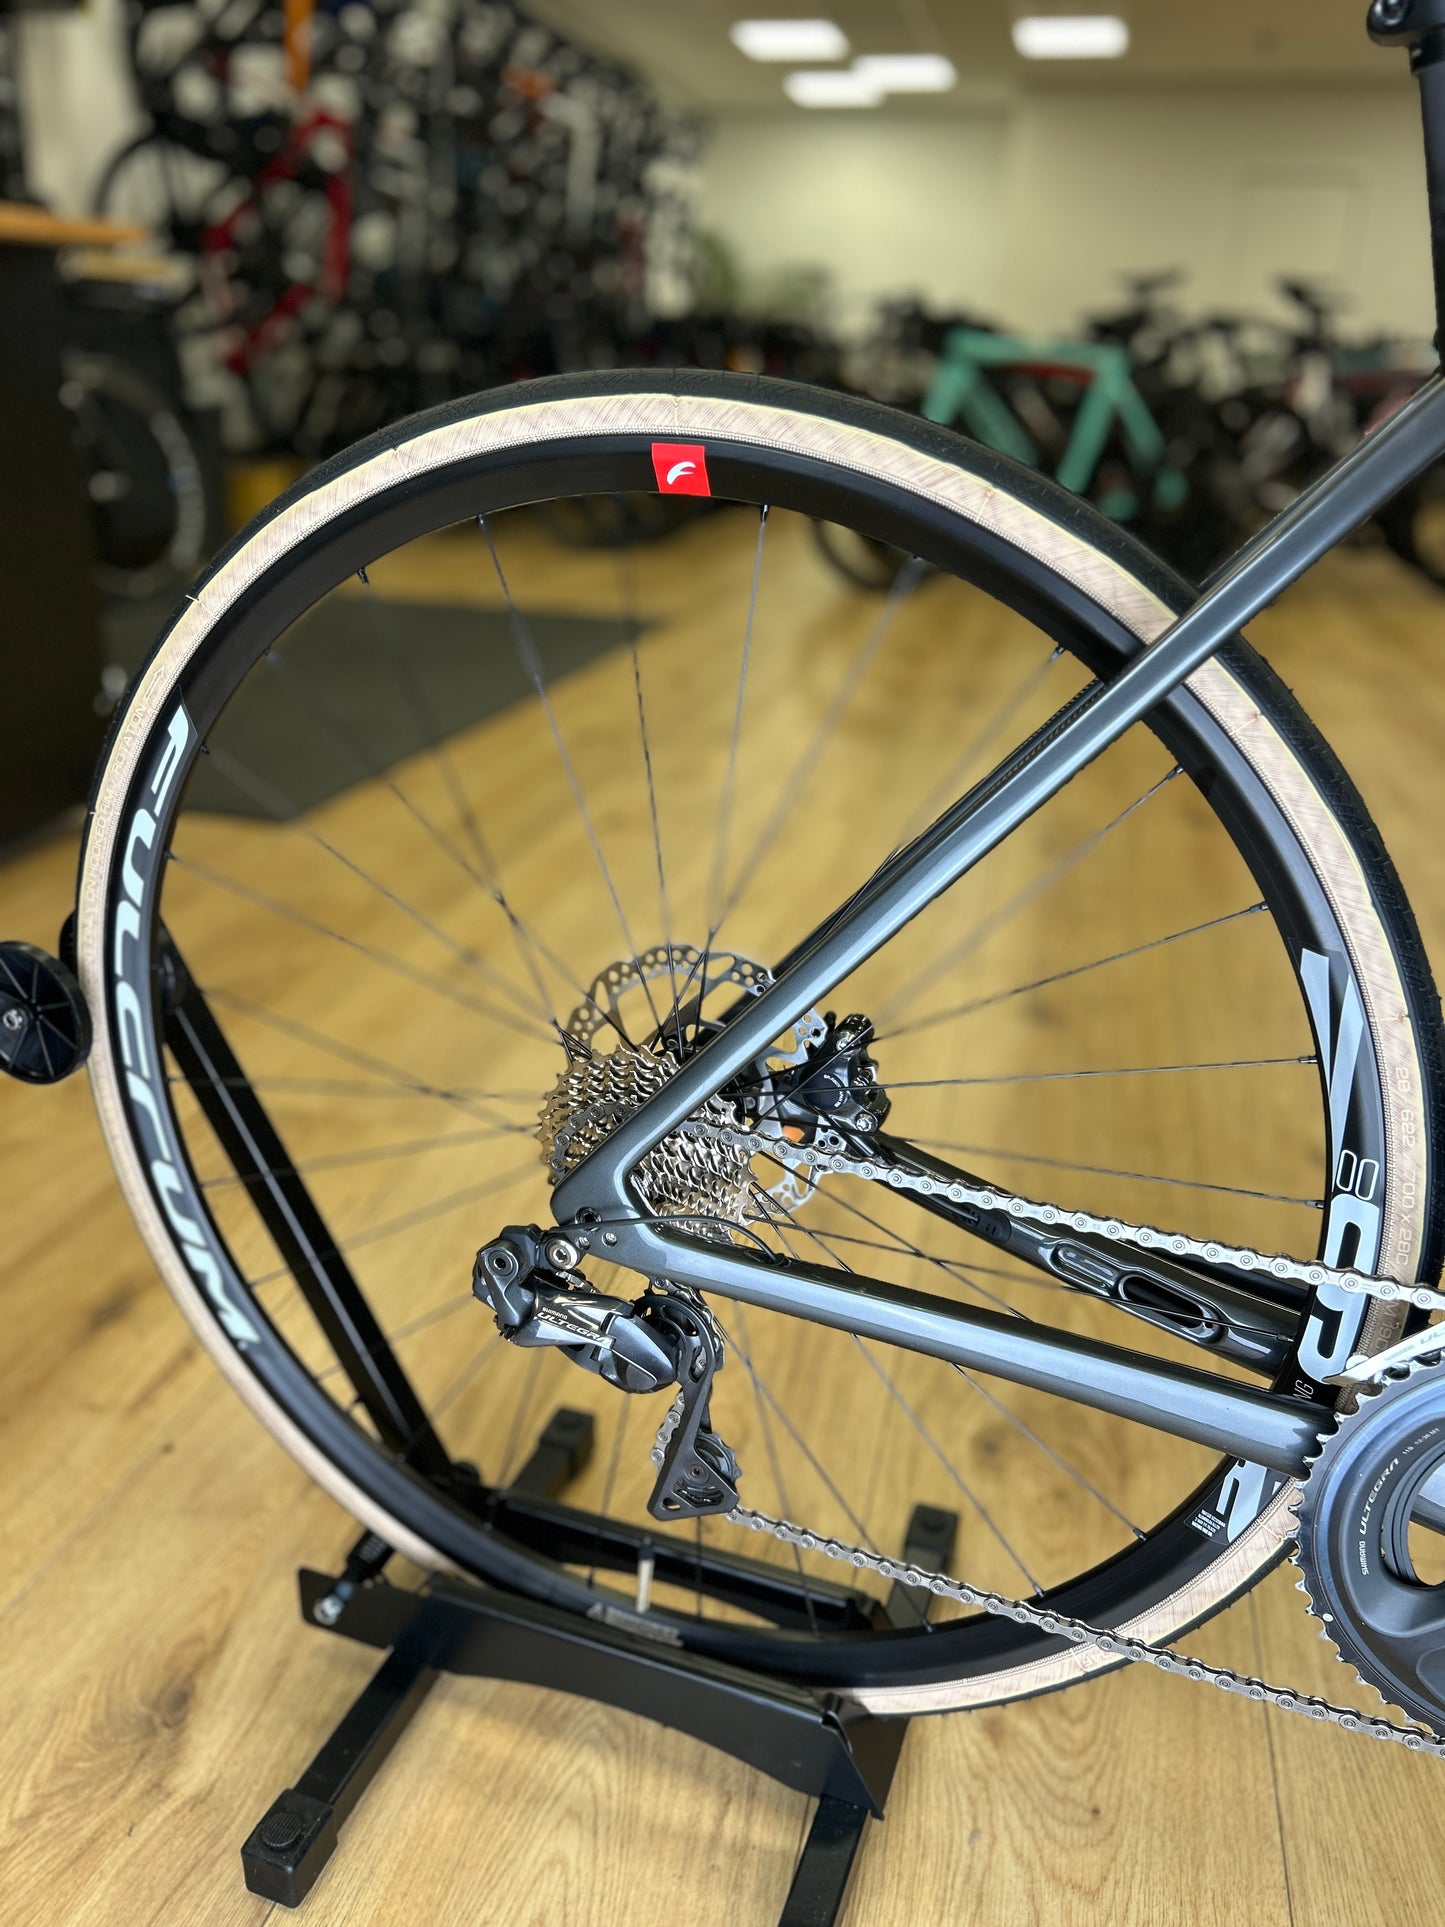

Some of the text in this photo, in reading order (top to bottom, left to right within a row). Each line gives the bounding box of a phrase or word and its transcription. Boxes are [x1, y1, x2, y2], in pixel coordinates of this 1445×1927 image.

[114, 702, 147, 773] ROTATION
[115, 704, 260, 1344] FULCRUM
[538, 1311, 608, 1344] ULTEGRA
[1359, 1457, 1400, 1536] ULTEGRA
[1359, 1540, 1370, 1576] SHIMANO
